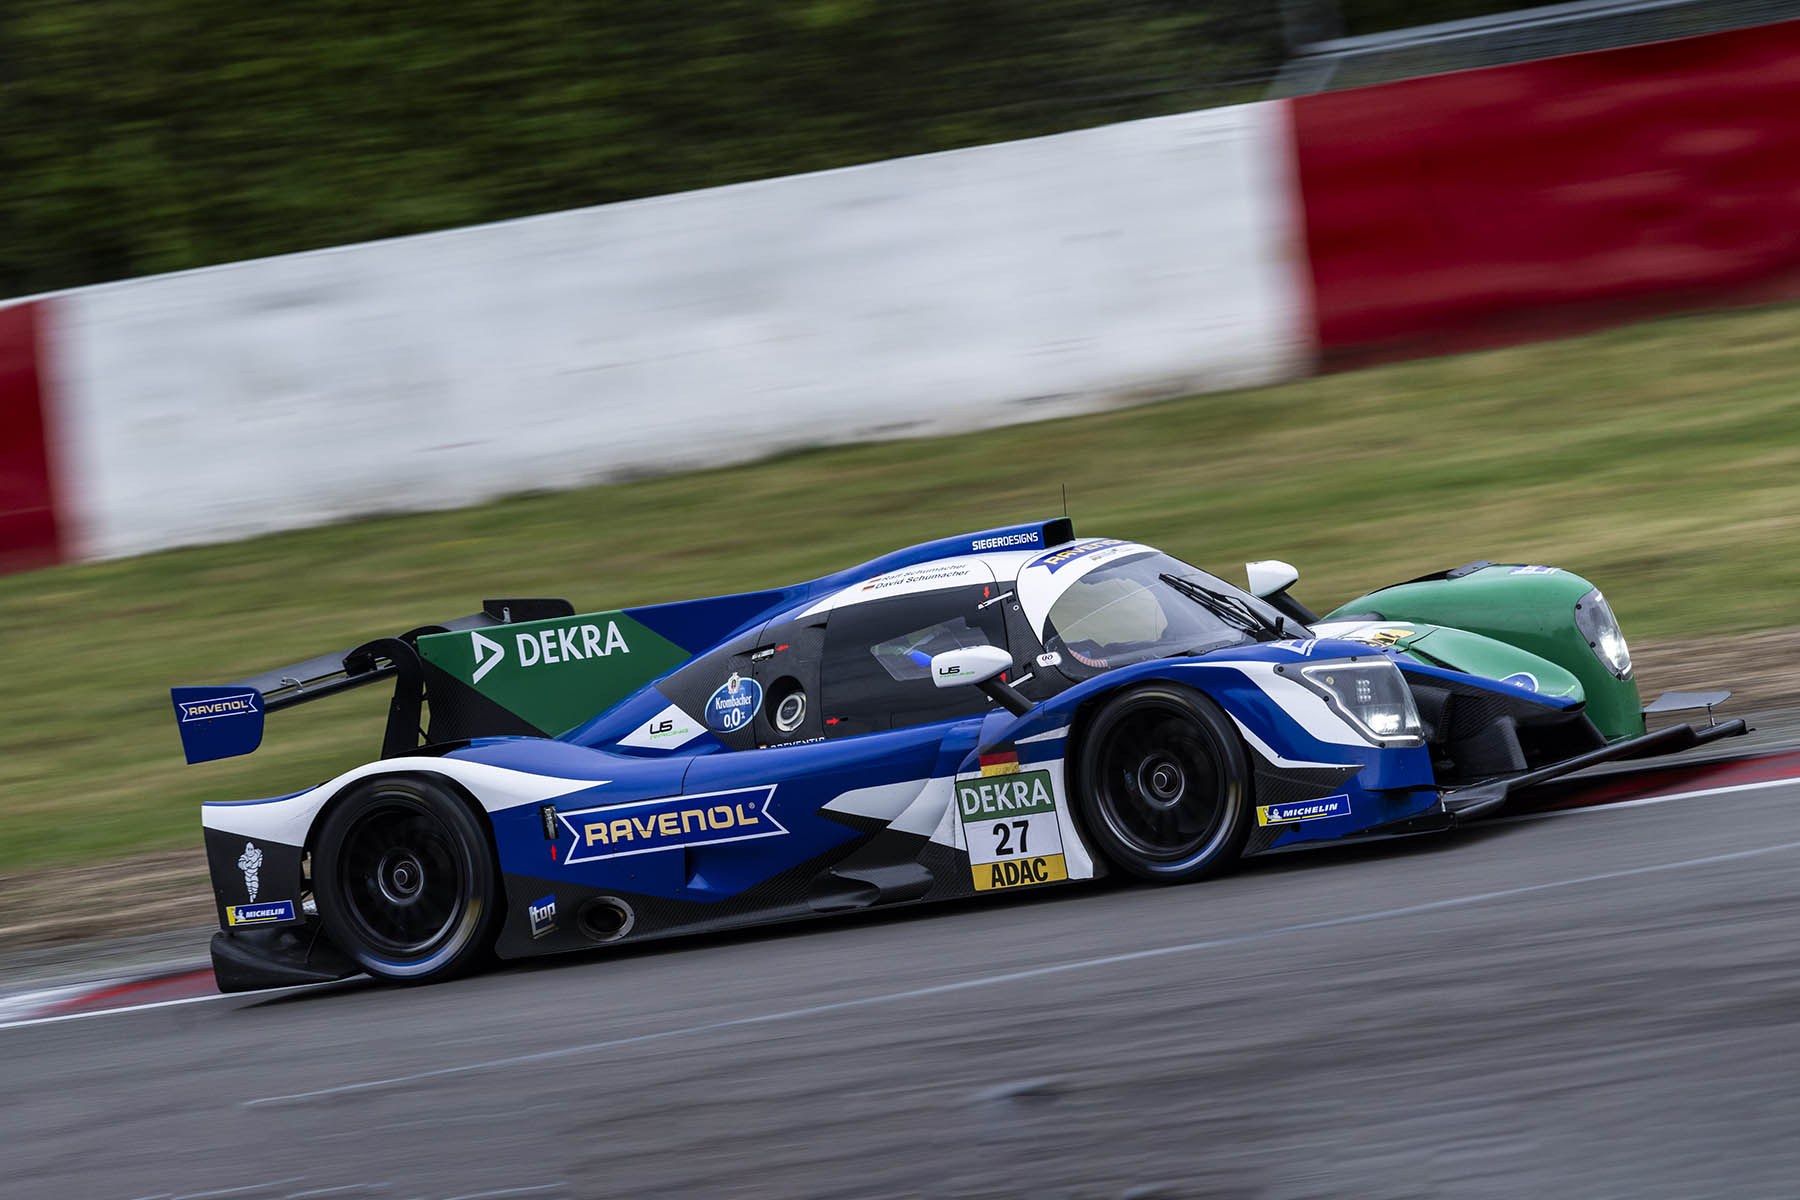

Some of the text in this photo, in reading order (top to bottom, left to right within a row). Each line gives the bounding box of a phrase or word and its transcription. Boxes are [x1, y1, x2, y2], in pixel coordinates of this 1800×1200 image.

[972, 532, 1038, 550] SIEGERDESIGNS
[875, 570, 969, 589] David Schumacher
[515, 620, 630, 667] DEKRA
[188, 700, 249, 716] RAVENOL
[715, 693, 752, 710] Krombacher
[960, 778, 1051, 816] DEKRA
[1283, 803, 1338, 817] MICHELIN
[584, 804, 759, 847] RAVENOL
[992, 820, 1029, 856] 27
[991, 858, 1049, 888] ADAC
[245, 908, 285, 918] MICHELIN
